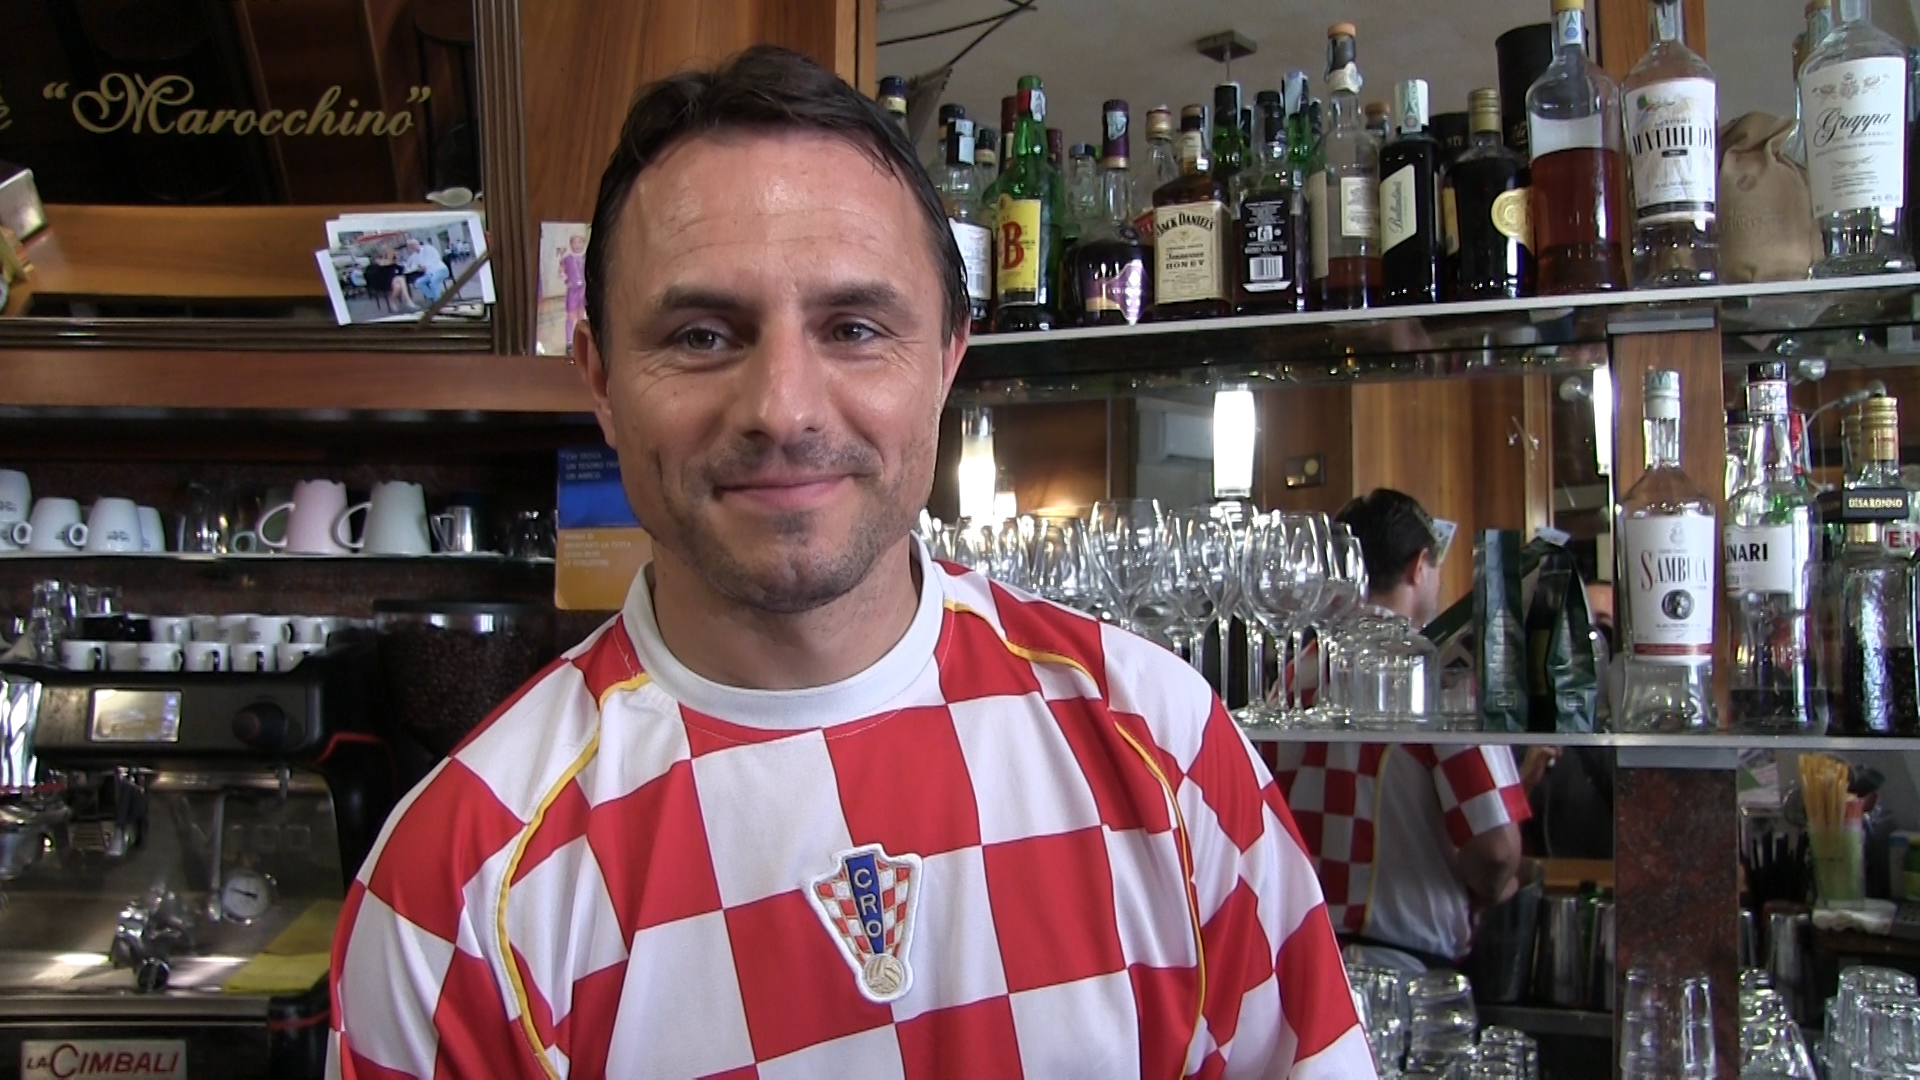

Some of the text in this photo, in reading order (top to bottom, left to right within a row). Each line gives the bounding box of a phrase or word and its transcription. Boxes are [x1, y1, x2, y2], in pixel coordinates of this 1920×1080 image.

[1813, 107, 1892, 147] Grappa
[1156, 216, 1178, 237] JACK
[1166, 260, 1205, 270] HONEY
[1848, 497, 1903, 509] DISARONNO
[1640, 549, 1708, 592] SAMBUCA
[853, 868, 883, 939] CRO
[26, 1043, 179, 1079] LA CIMBALI
